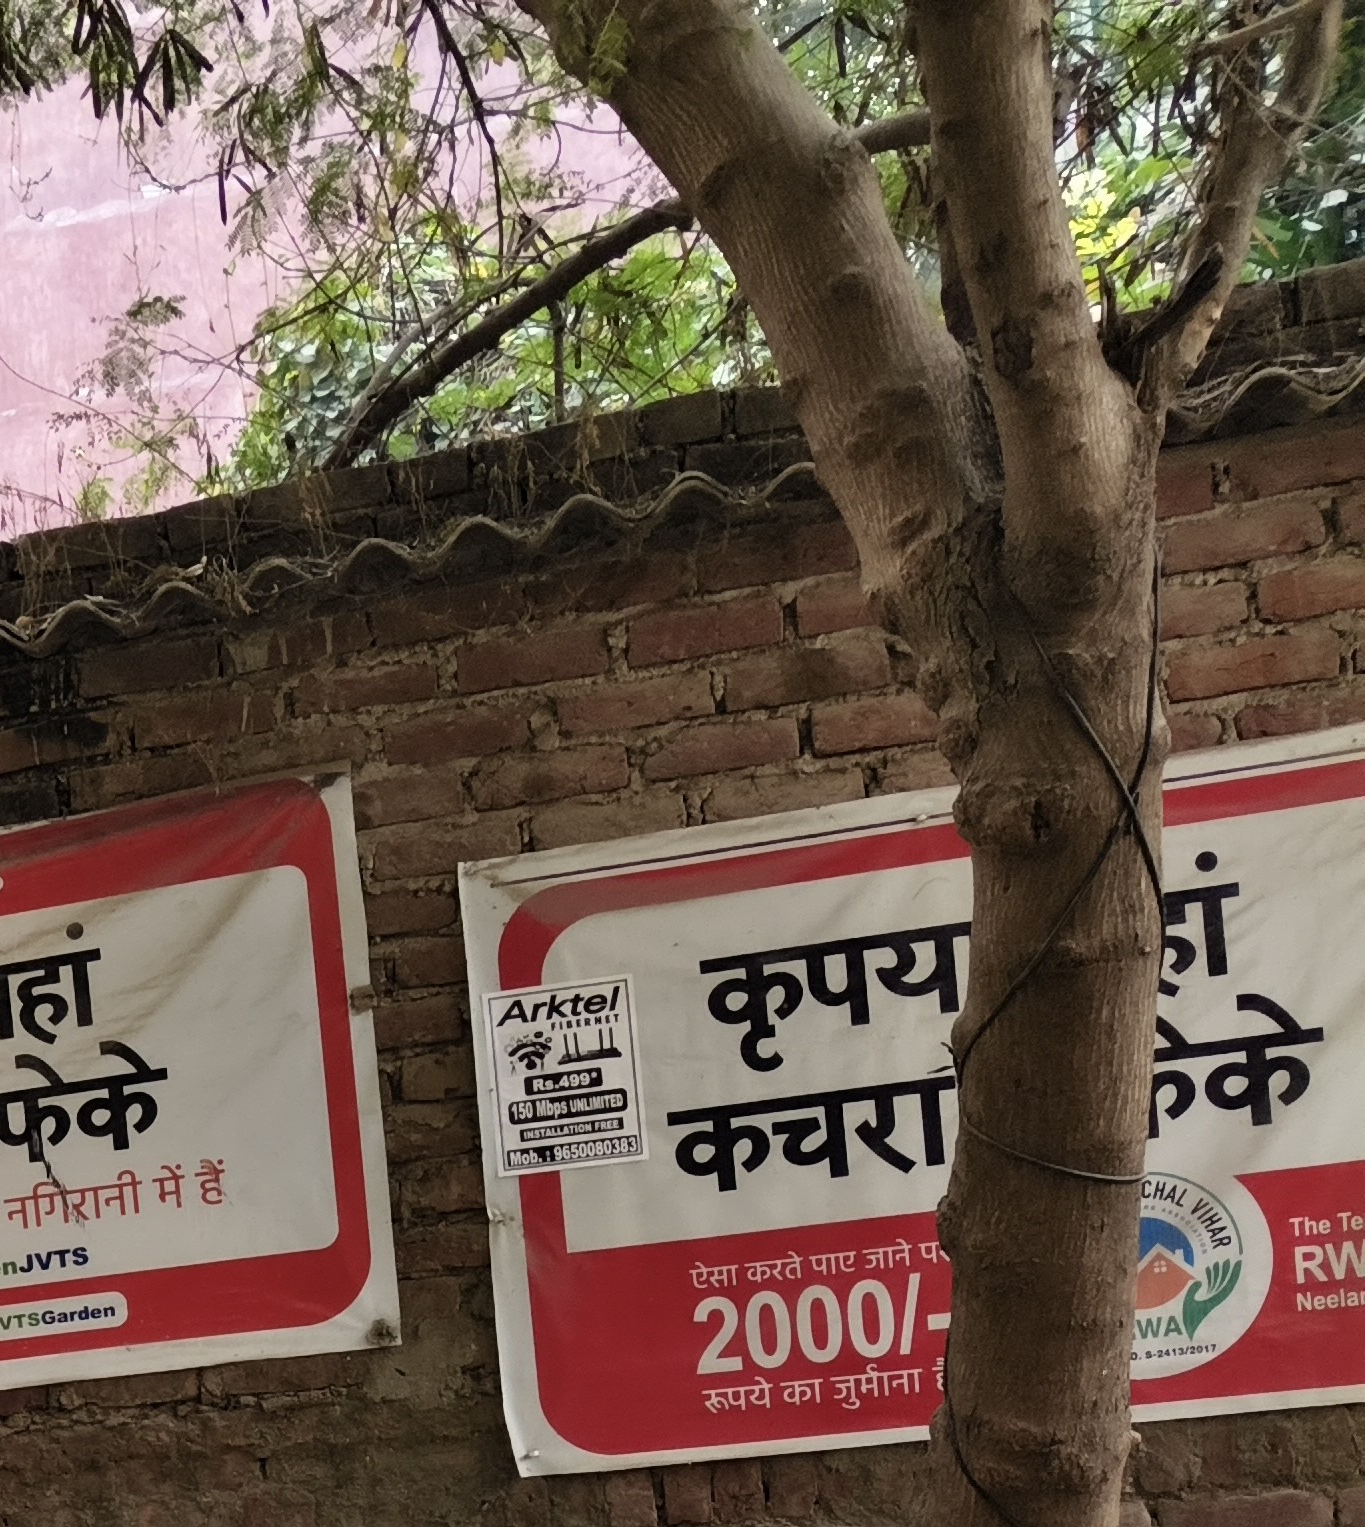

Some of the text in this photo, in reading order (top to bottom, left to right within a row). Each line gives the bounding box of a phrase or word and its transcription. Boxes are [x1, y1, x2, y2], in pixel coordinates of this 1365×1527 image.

[699, 850, 1240, 1073] कृपय हां
[496, 985, 621, 1027] Arktel
[550, 1012, 620, 1032] FIBERNET
[511, 1093, 623, 1121] 150 Mbps UNLIMITED
[523, 1119, 620, 1140] INSTALLATION FREE
[666, 1075, 956, 1193] कचरा
[553, 1136, 638, 1161] 9650080383
[151, 1163, 186, 1209] में
[1141, 1180, 1232, 1250] CHAL VIHAR
[1288, 1211, 1365, 1237] The Te
[689, 1262, 738, 1289] ऐसा
[744, 1251, 802, 1284] करते
[809, 1250, 857, 1276] पाए
[862, 1238, 912, 1269] जाने
[1294, 1238, 1365, 1285] RW
[1296, 1288, 1365, 1312] Neela
[693, 1272, 952, 1375] 2000/-
[1133, 1315, 1184, 1340] WA
[780, 1378, 823, 1406] का
